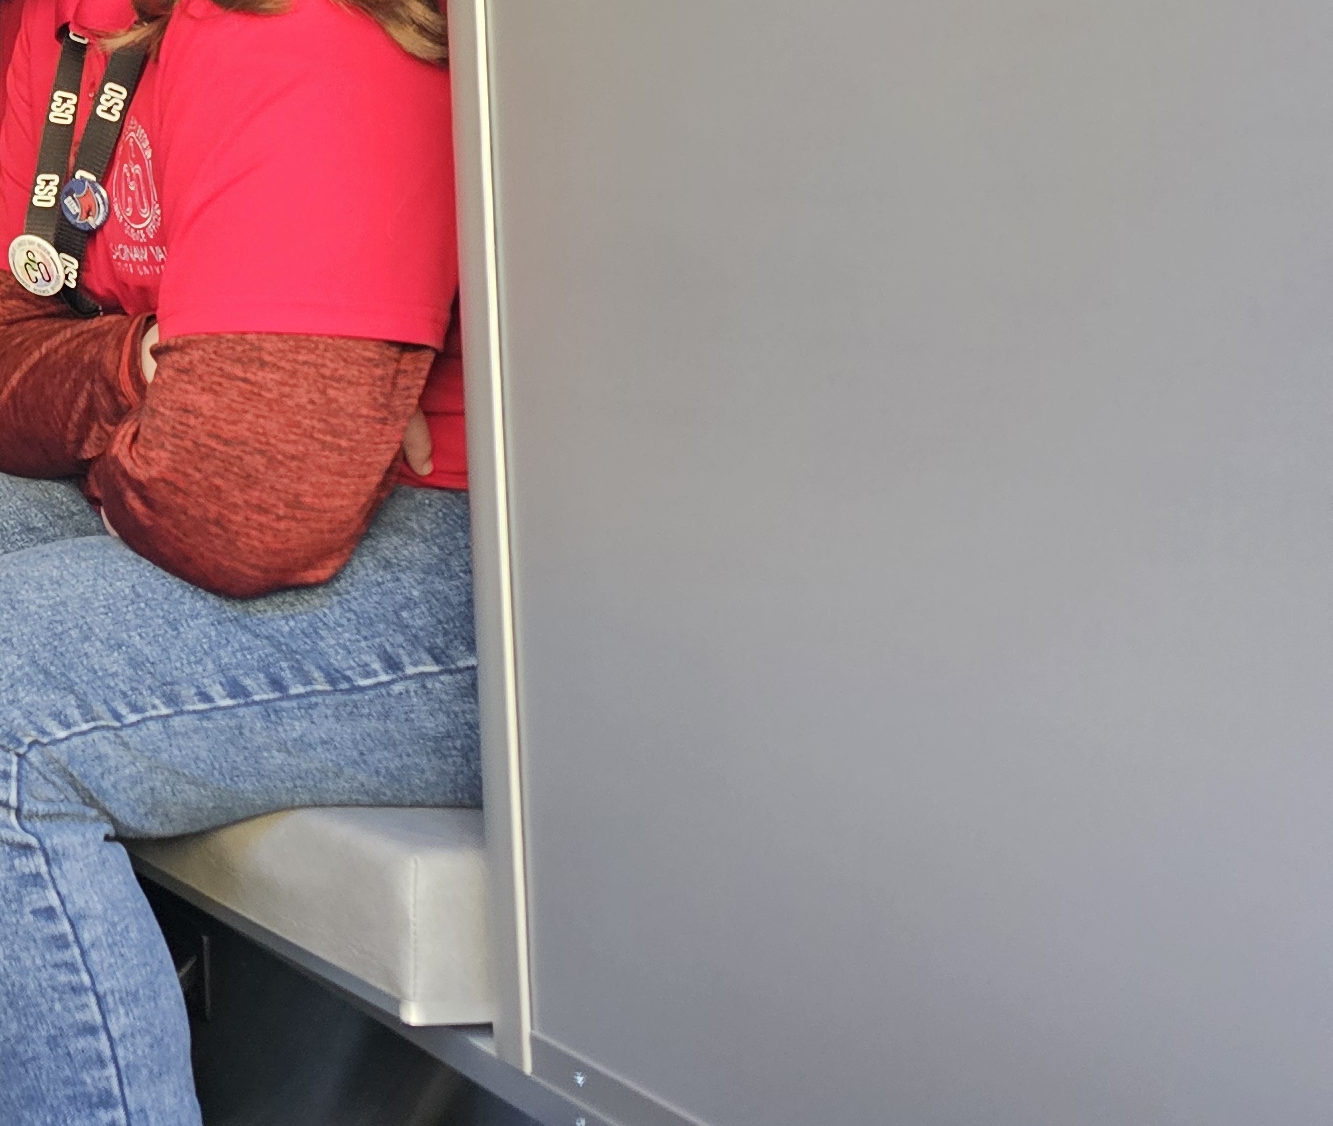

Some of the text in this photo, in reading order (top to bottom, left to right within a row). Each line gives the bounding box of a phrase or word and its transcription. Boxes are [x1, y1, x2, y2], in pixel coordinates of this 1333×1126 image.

[48, 90, 78, 125] CSO
[96, 81, 128, 122] CSO
[32, 174, 59, 208] CSO
